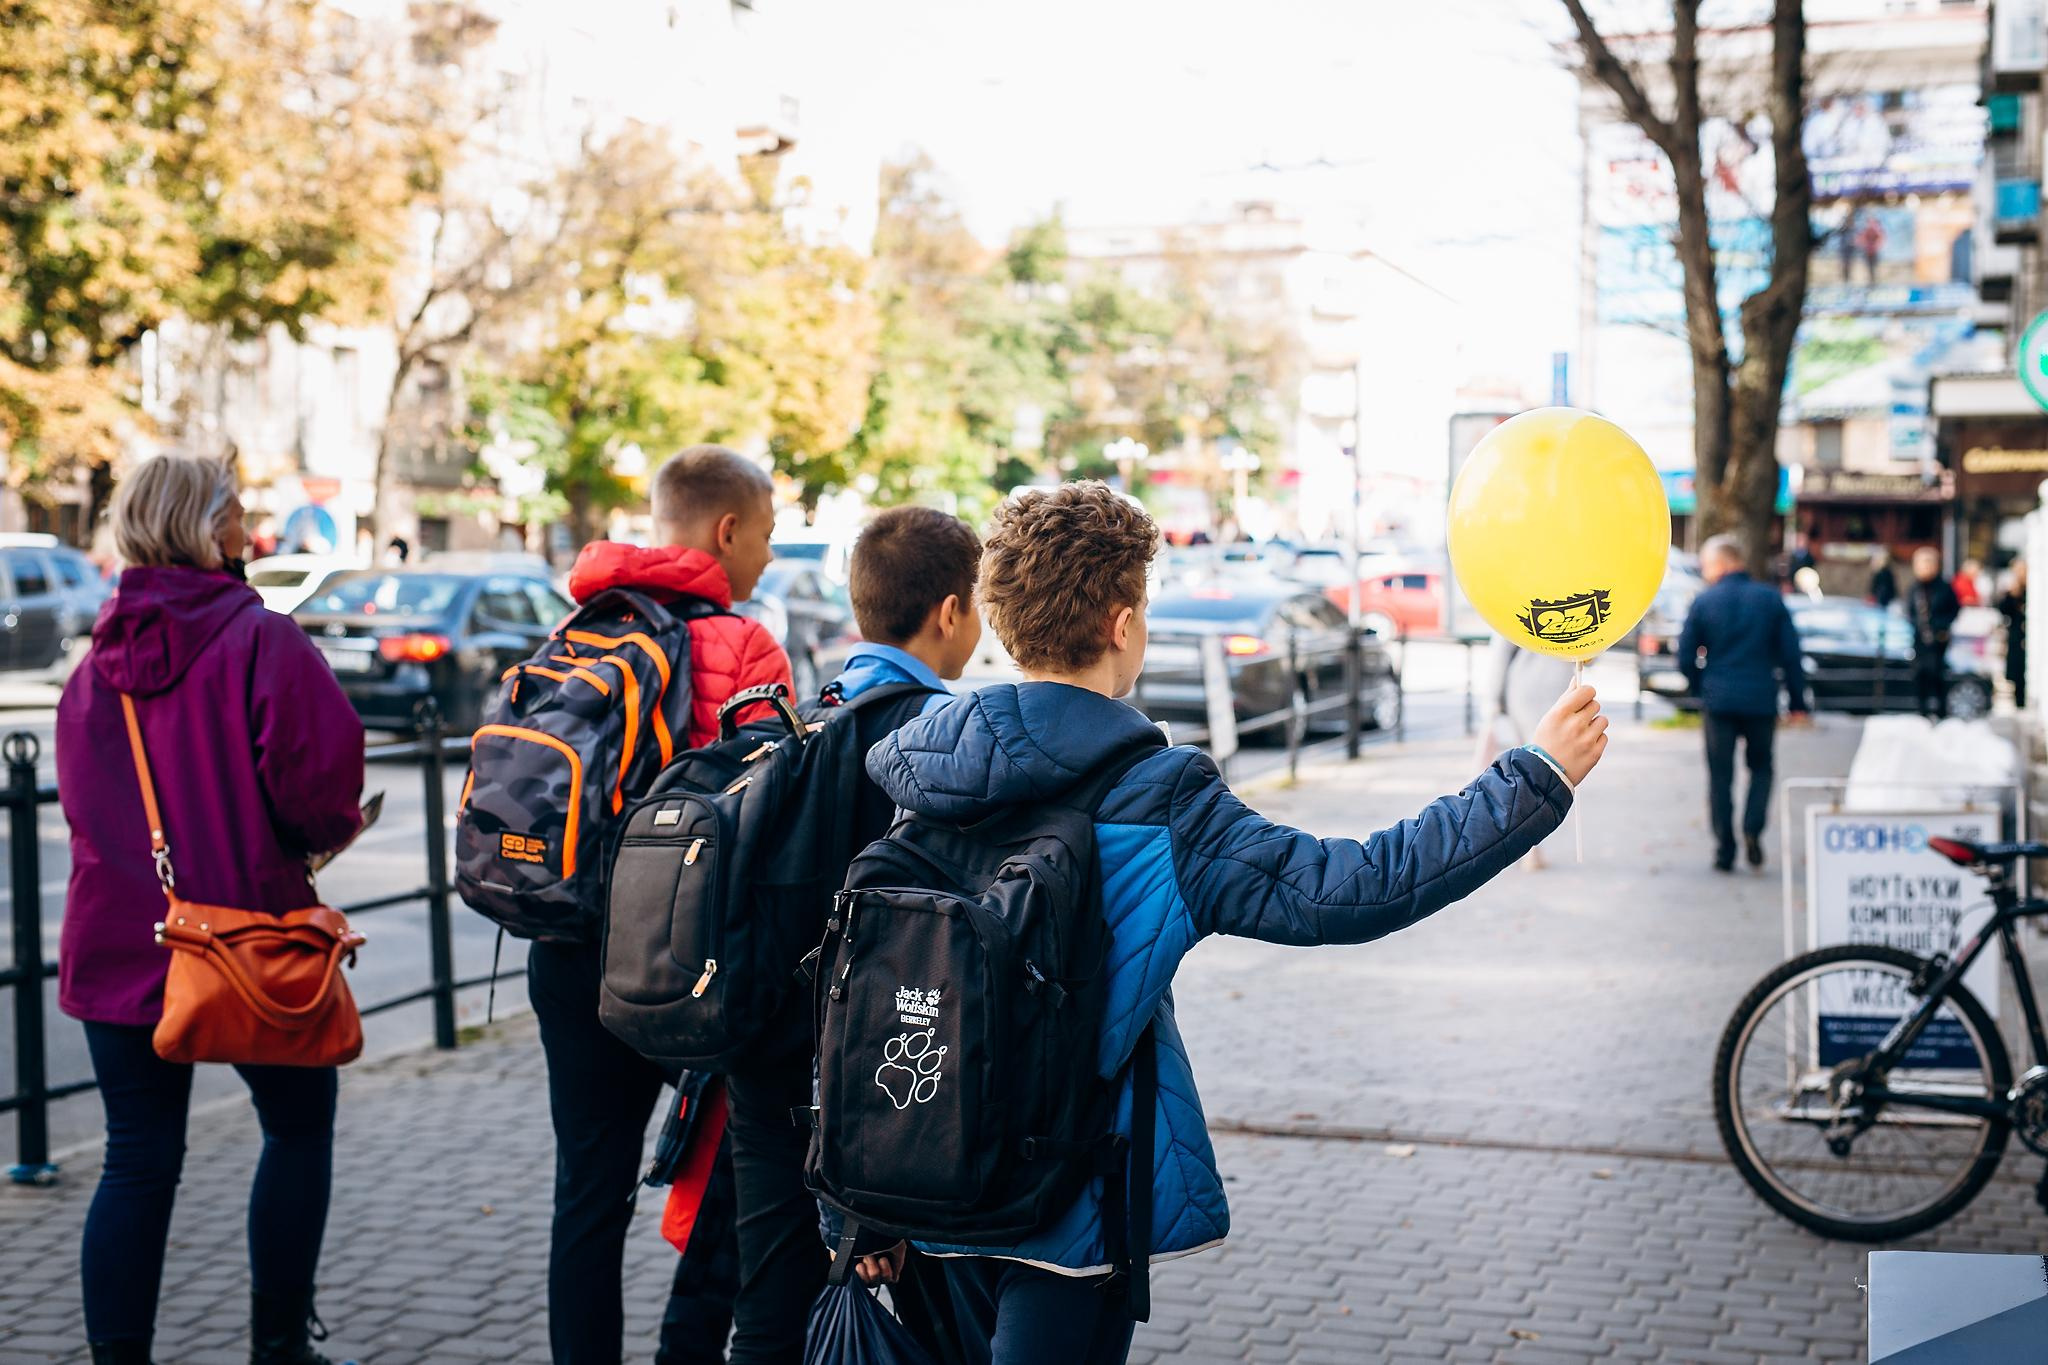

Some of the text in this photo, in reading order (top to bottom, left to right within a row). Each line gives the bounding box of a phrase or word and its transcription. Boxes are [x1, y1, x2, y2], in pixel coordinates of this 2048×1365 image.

[895, 986, 924, 1001] Jack
[895, 997, 939, 1017] Wolfskin
[900, 1014, 931, 1026] BERKELEY
